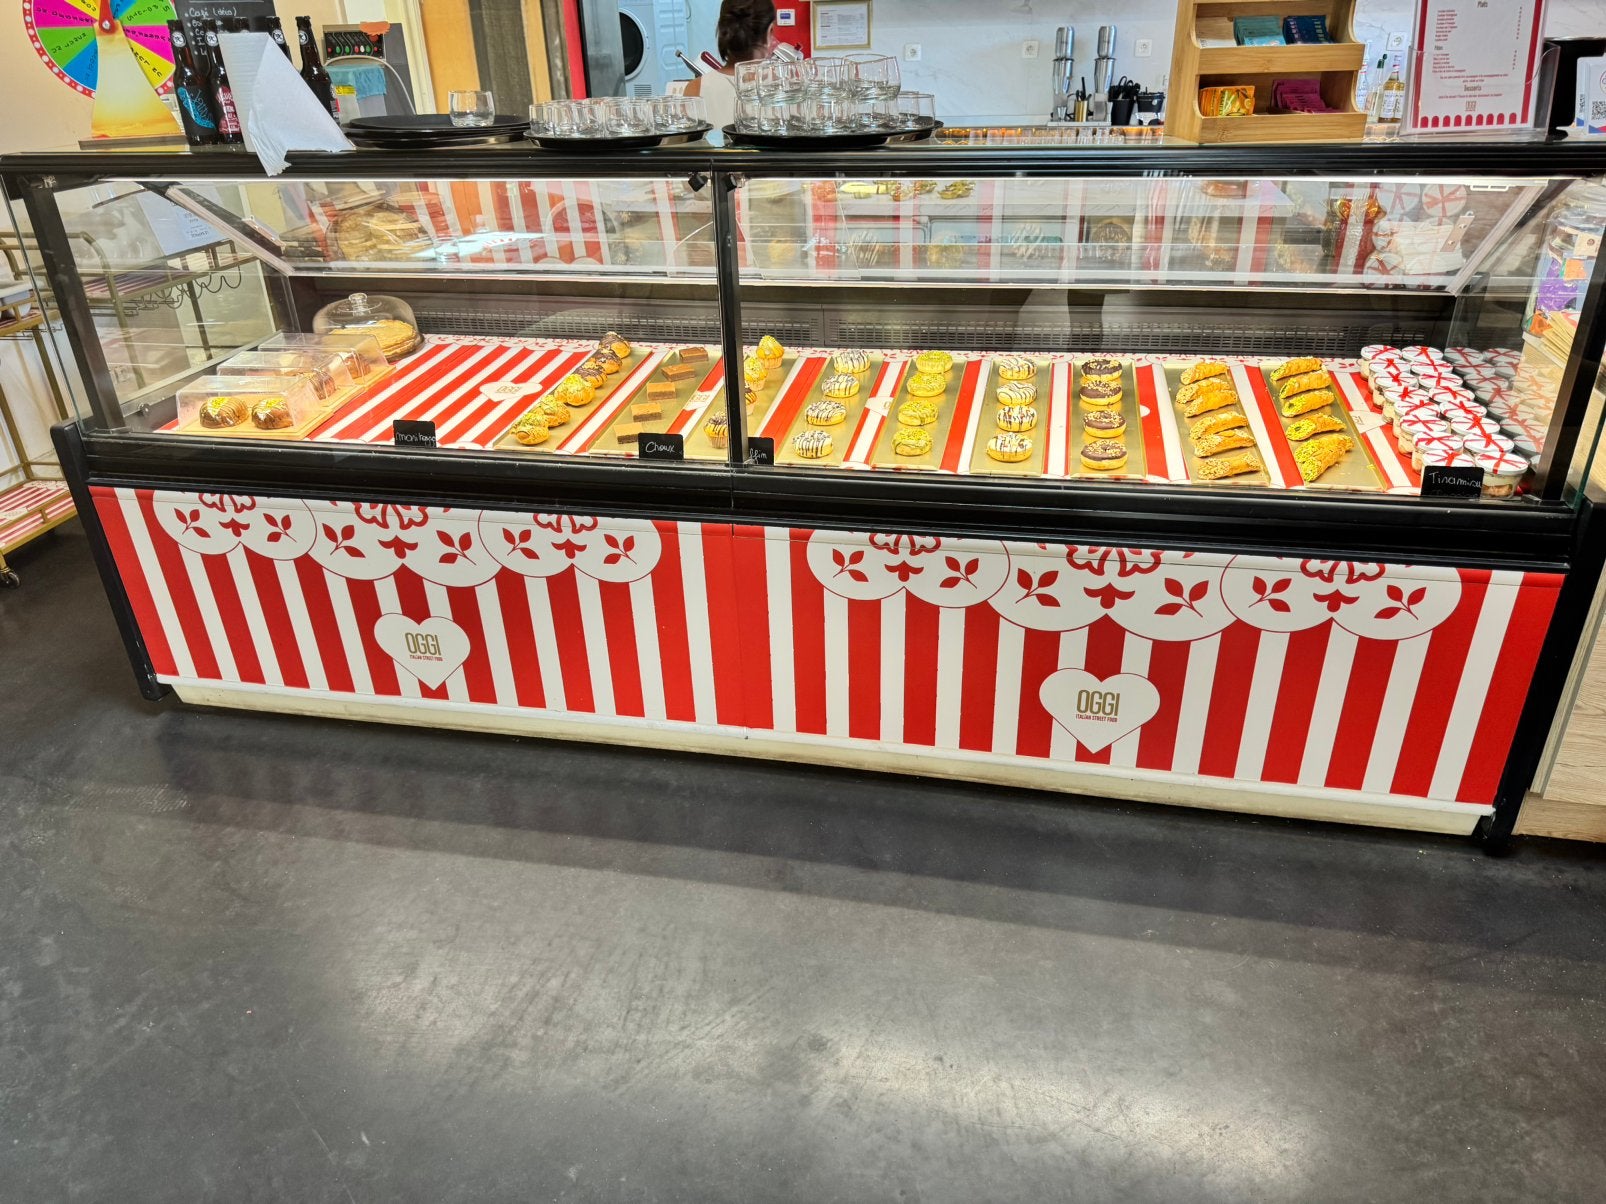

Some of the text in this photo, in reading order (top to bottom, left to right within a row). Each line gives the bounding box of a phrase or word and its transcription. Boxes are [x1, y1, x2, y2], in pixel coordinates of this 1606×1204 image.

[645, 441, 676, 453] Choux
[405, 632, 441, 655] OGGI
[1077, 690, 1120, 716] OGGI
